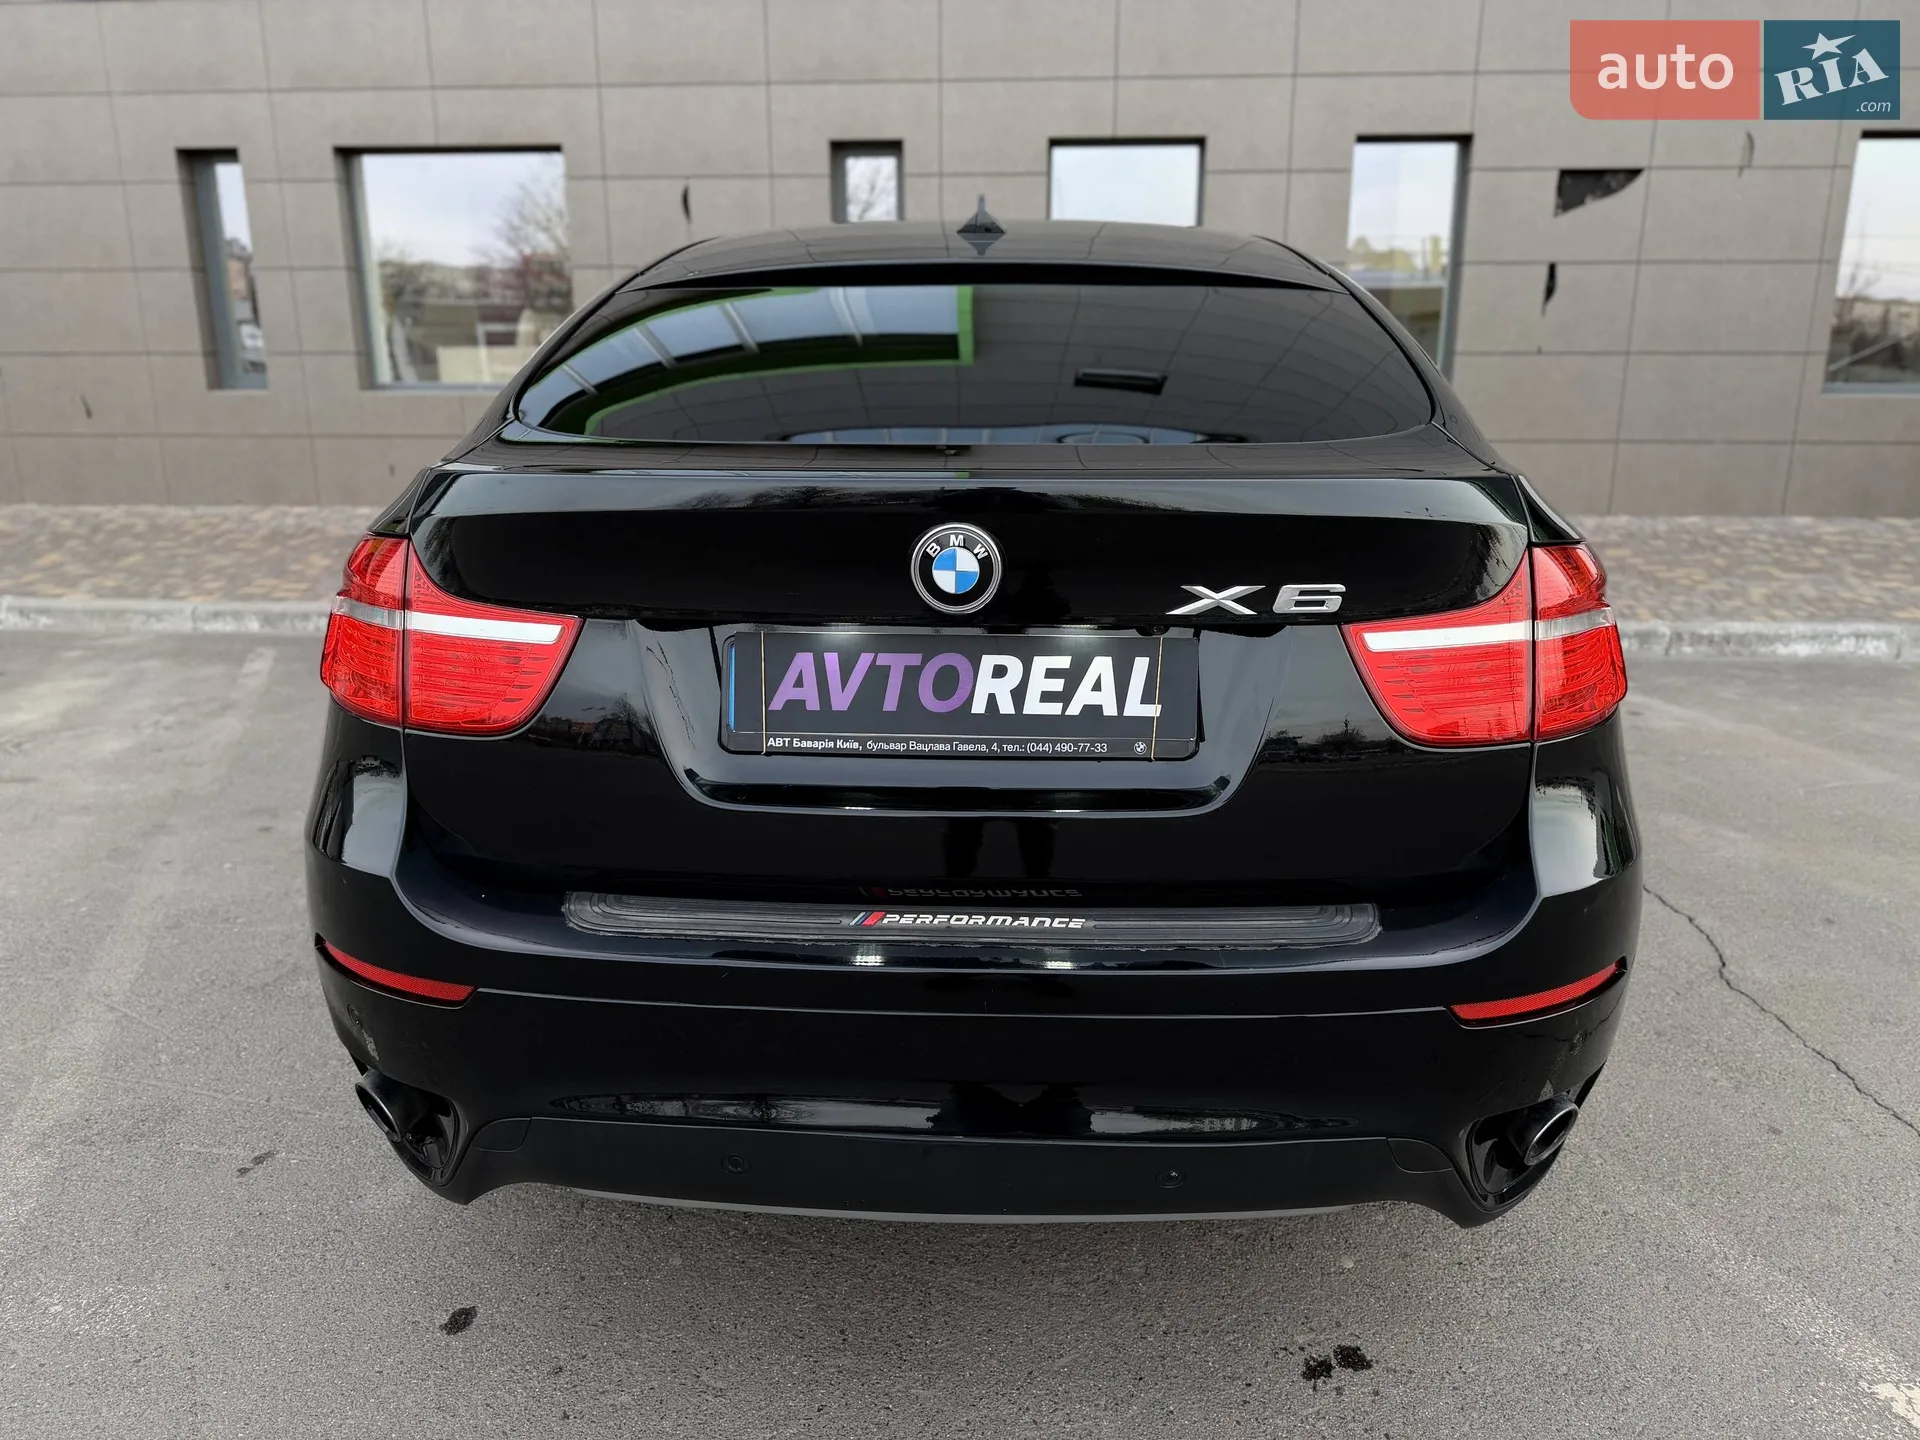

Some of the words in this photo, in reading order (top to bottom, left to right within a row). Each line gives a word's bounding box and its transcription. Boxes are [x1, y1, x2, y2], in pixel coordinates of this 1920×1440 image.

[925, 533, 989, 560] BMW
[768, 651, 1162, 717] AVTOREAL
[767, 737, 791, 748] АВТ
[793, 738, 834, 750] Баварія
[836, 738, 863, 751] Київ,
[866, 740, 907, 752] бульвар
[909, 741, 951, 753] Вацлава
[952, 741, 989, 753] Гавела,
[991, 742, 1001, 754] 4,
[1026, 742, 1053, 754] (044)
[1054, 743, 1108, 753] 490-77-33
[882, 914, 1087, 929] PERFORMANCE
